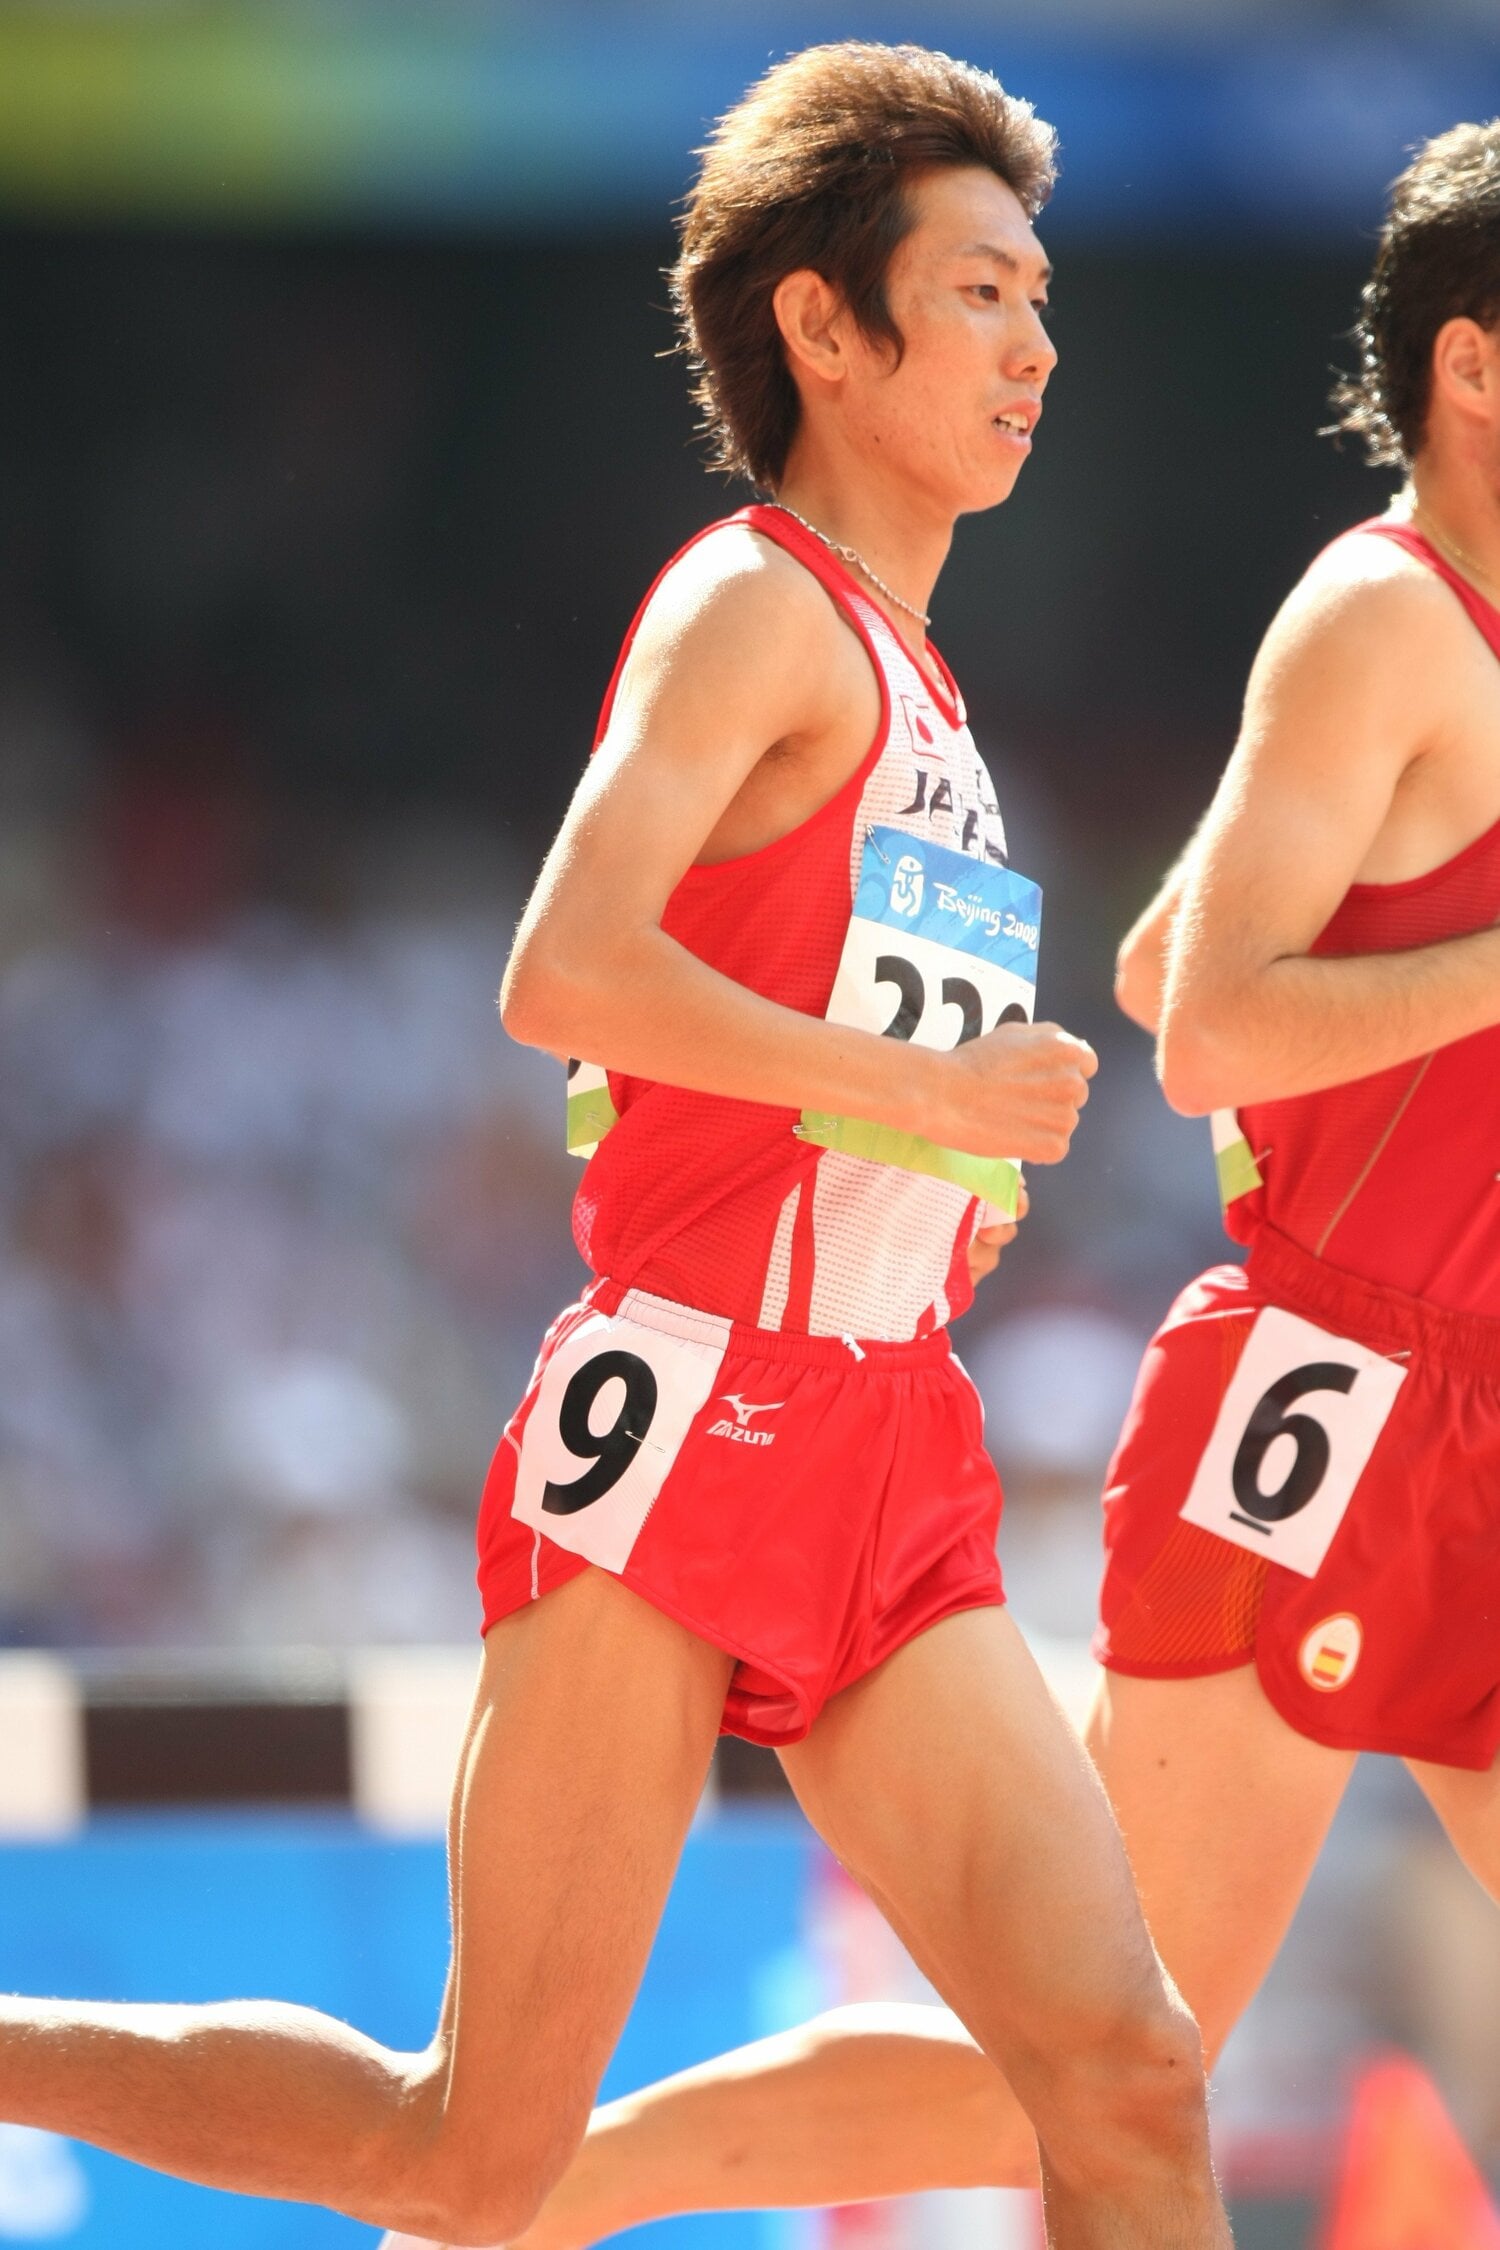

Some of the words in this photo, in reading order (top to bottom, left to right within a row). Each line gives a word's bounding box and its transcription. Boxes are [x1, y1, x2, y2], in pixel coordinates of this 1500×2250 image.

[933, 882, 1002, 937] Beijing
[1002, 913, 1038, 950] 2008
[874, 954, 1029, 1050] 22
[541, 1350, 658, 1516] 9
[1231, 1361, 1360, 1523] 6
